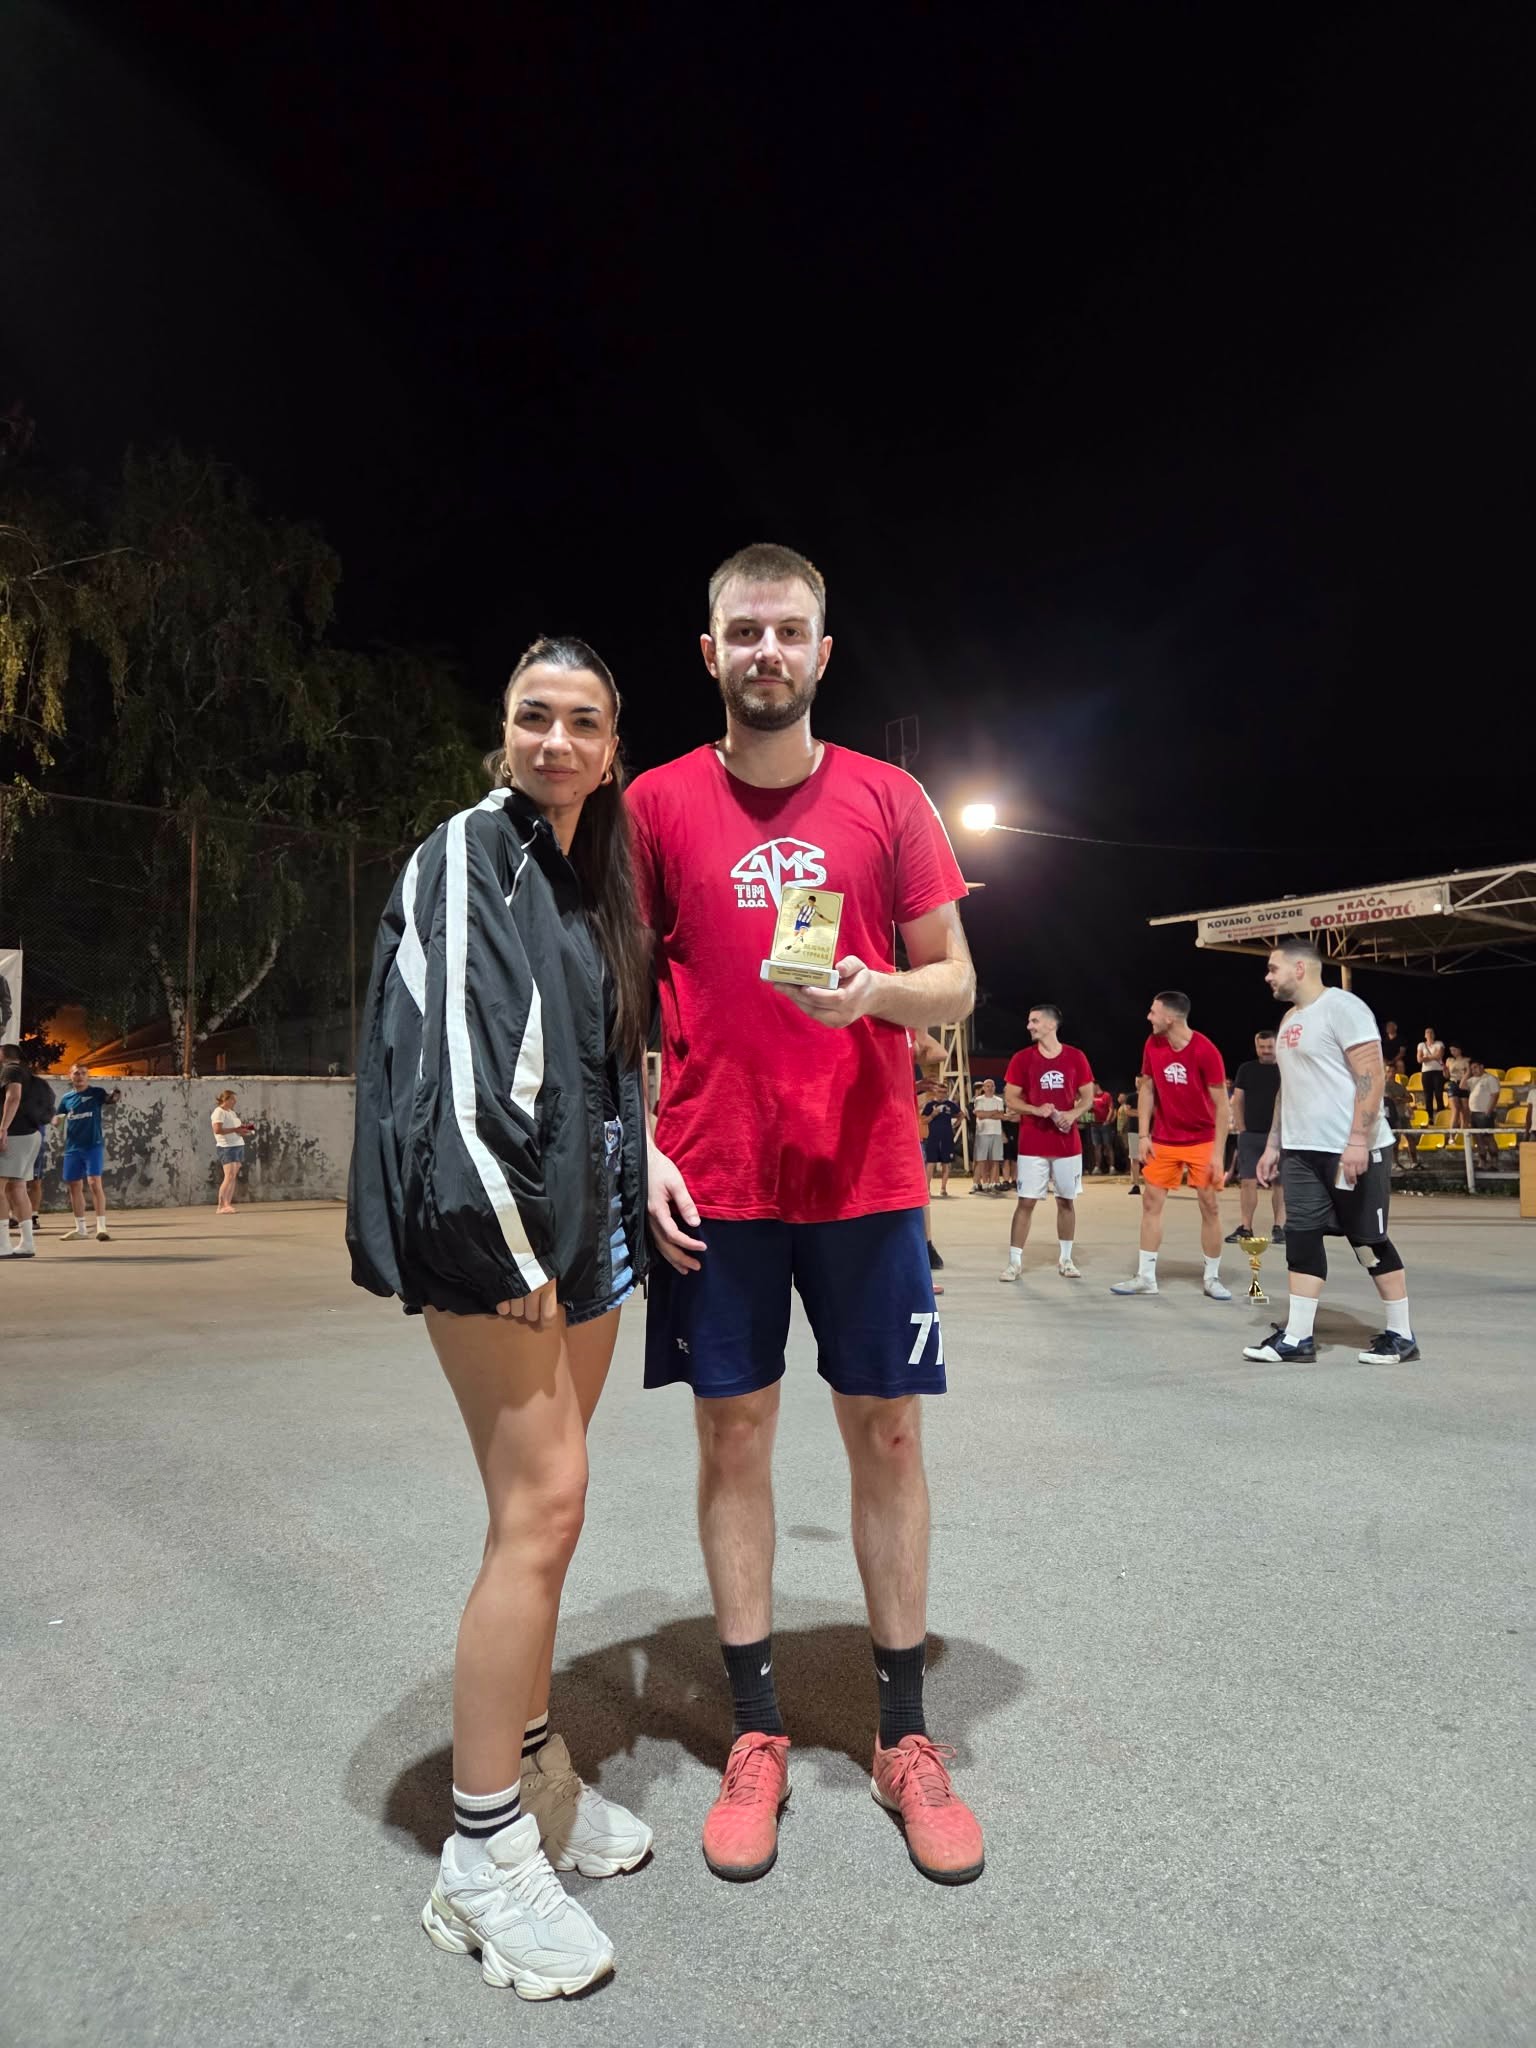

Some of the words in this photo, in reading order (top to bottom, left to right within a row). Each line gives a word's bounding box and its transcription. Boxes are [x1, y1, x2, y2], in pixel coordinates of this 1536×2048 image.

[730, 837, 827, 892] AMS
[734, 884, 765, 899] TIM
[738, 899, 768, 908] D.O.O.
[1207, 916, 1252, 929] KOVANO
[1040, 1070, 1064, 1086] AMS
